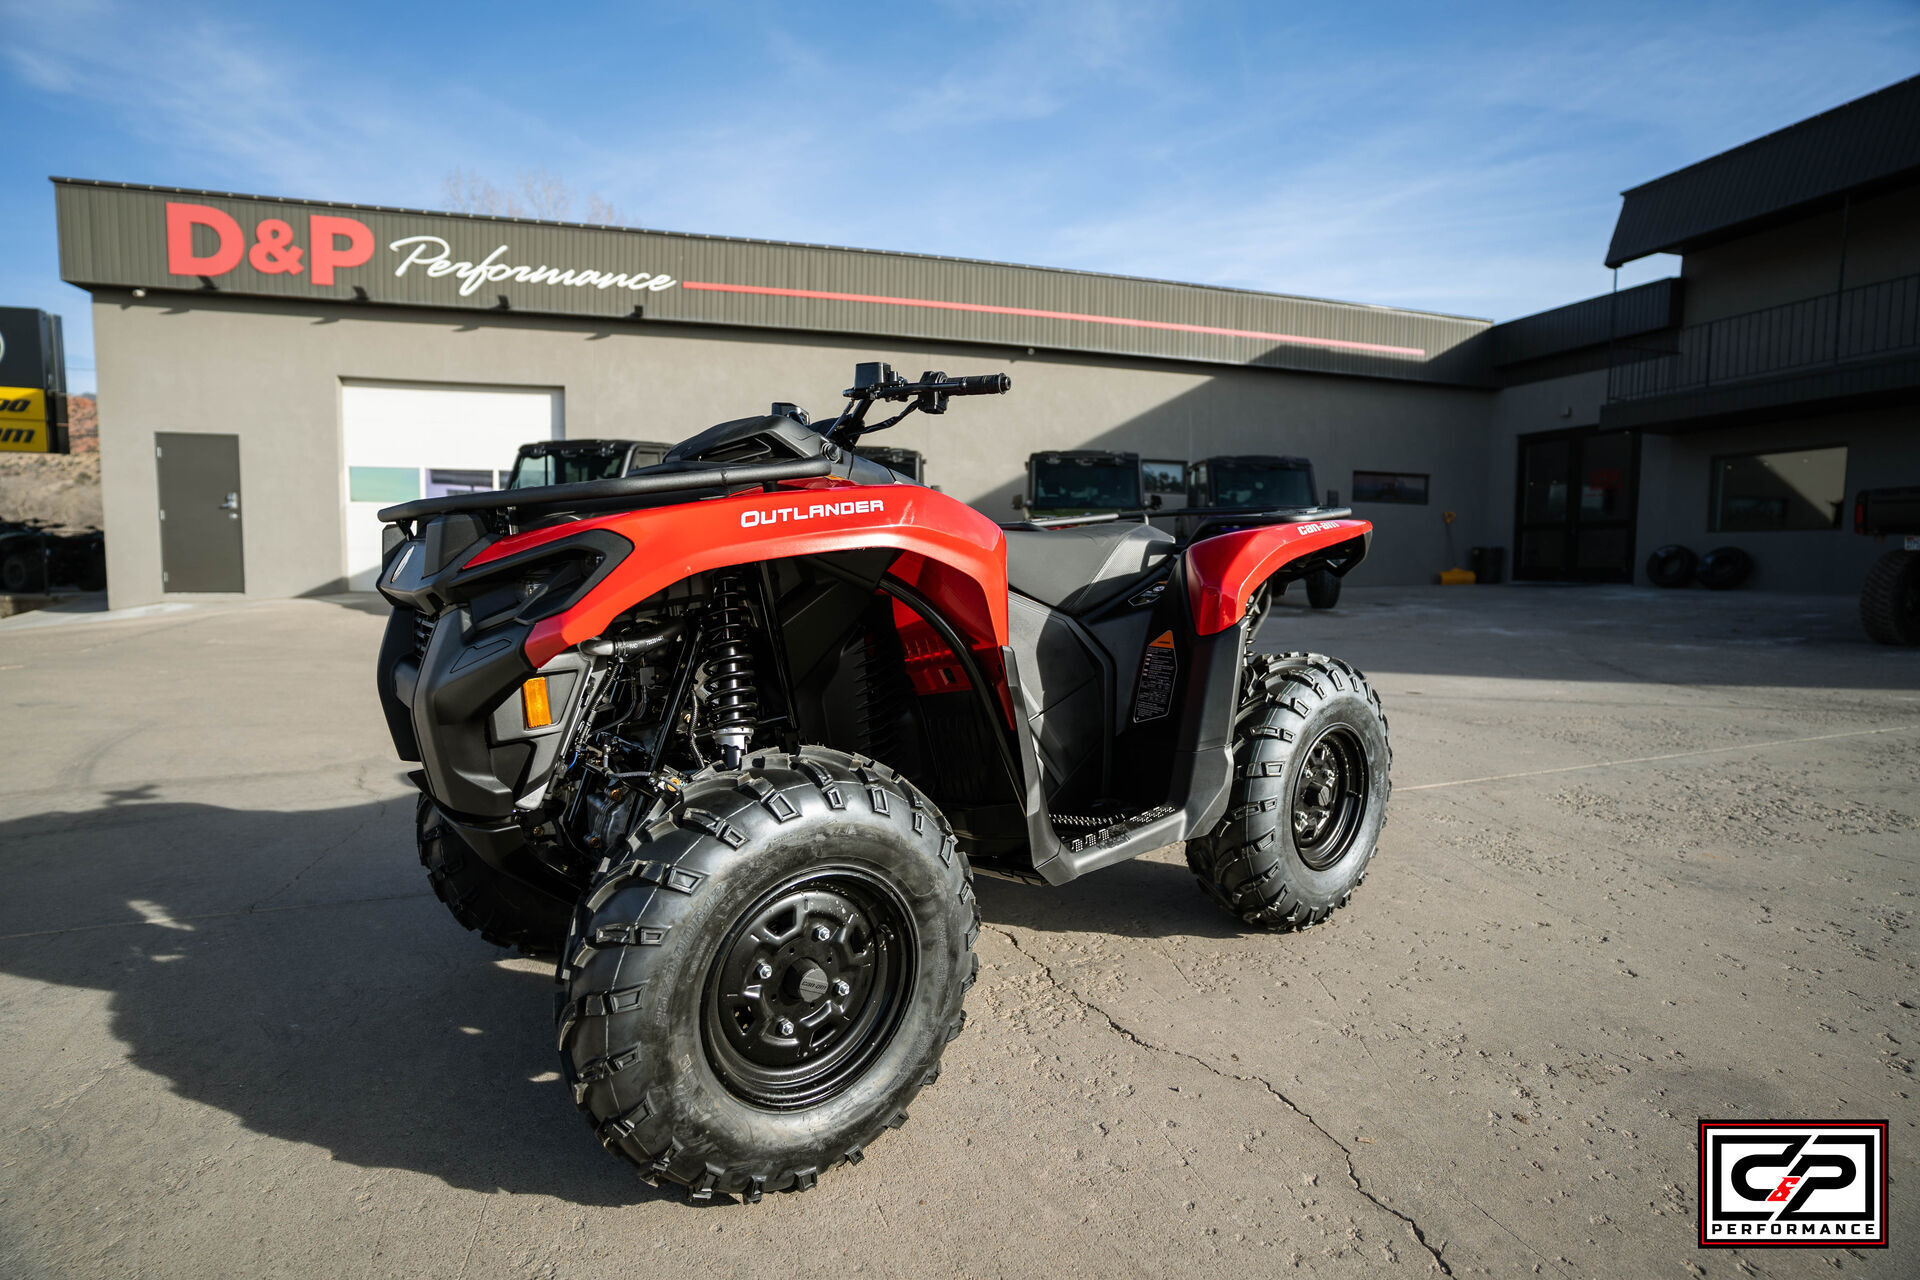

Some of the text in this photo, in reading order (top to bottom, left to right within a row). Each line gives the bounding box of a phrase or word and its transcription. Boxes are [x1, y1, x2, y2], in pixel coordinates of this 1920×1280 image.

[166, 202, 677, 297] D&P Performance
[740, 500, 884, 528] OUTLANDER
[1297, 521, 1340, 535] can-am
